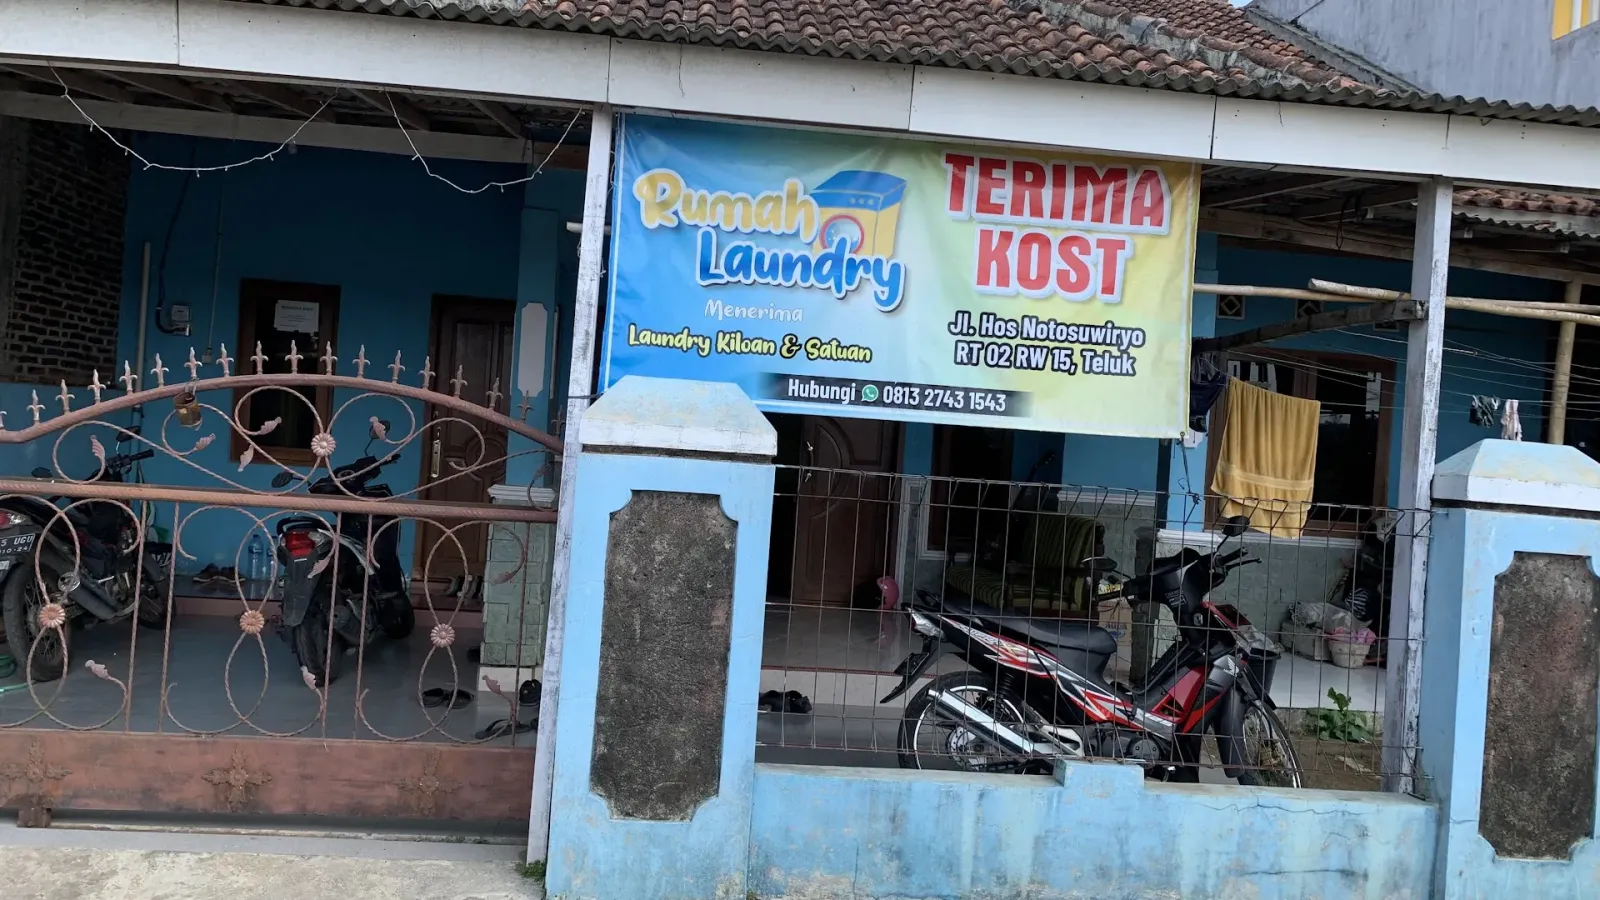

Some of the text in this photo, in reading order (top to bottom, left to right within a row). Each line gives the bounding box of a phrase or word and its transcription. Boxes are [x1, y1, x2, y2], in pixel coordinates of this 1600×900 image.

[635, 170, 817, 243] Rumah
[945, 153, 1165, 227] TERIMA
[698, 228, 904, 310] Laundry
[976, 229, 1126, 295] KOST
[704, 298, 803, 322] Menerima
[628, 324, 872, 362] Laundry Kiloan & Satuan
[949, 313, 1144, 349] Jl. Hos Notosuwiryo
[956, 342, 1135, 374] RT 02 RW 15, Teluk
[788, 378, 1006, 412] Hubungi 0813 2743 1543
